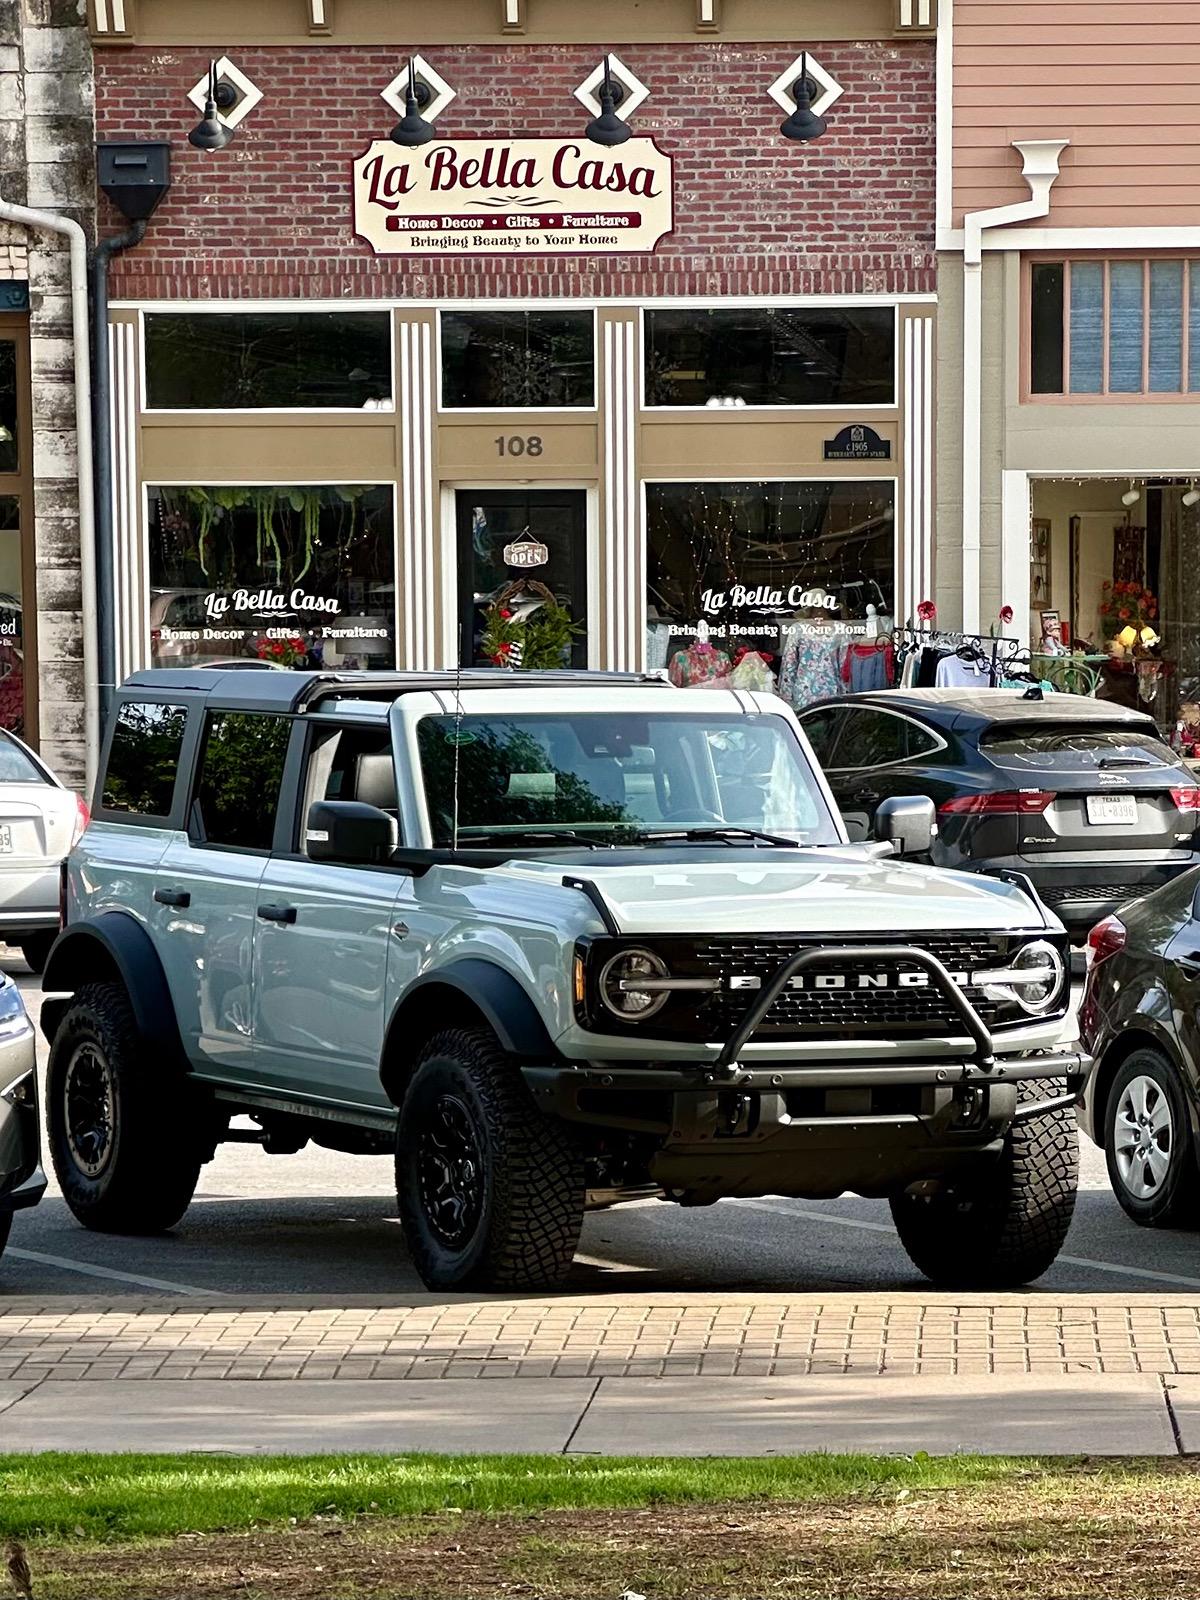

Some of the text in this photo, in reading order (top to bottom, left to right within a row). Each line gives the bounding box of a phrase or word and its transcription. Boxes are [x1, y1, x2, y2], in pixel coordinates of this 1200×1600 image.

[362, 144, 662, 210] La Bella Casa
[398, 214, 629, 230] Home Decor Gifts Furniture
[410, 233, 618, 249] Bringing Beauty to Your Home
[494, 436, 543, 456] 108
[852, 442, 868, 451] 1905
[511, 553, 541, 564] OPEN
[204, 588, 341, 619] La Bella Casa
[701, 584, 840, 614] La Bella Casa
[0, 618, 16, 635] ed
[160, 626, 388, 640] Home Decor Gifts Furniture
[729, 624, 778, 637] Beauty
[782, 624, 796, 634] to
[800, 623, 831, 634] Your
[834, 622, 872, 634] Hom
